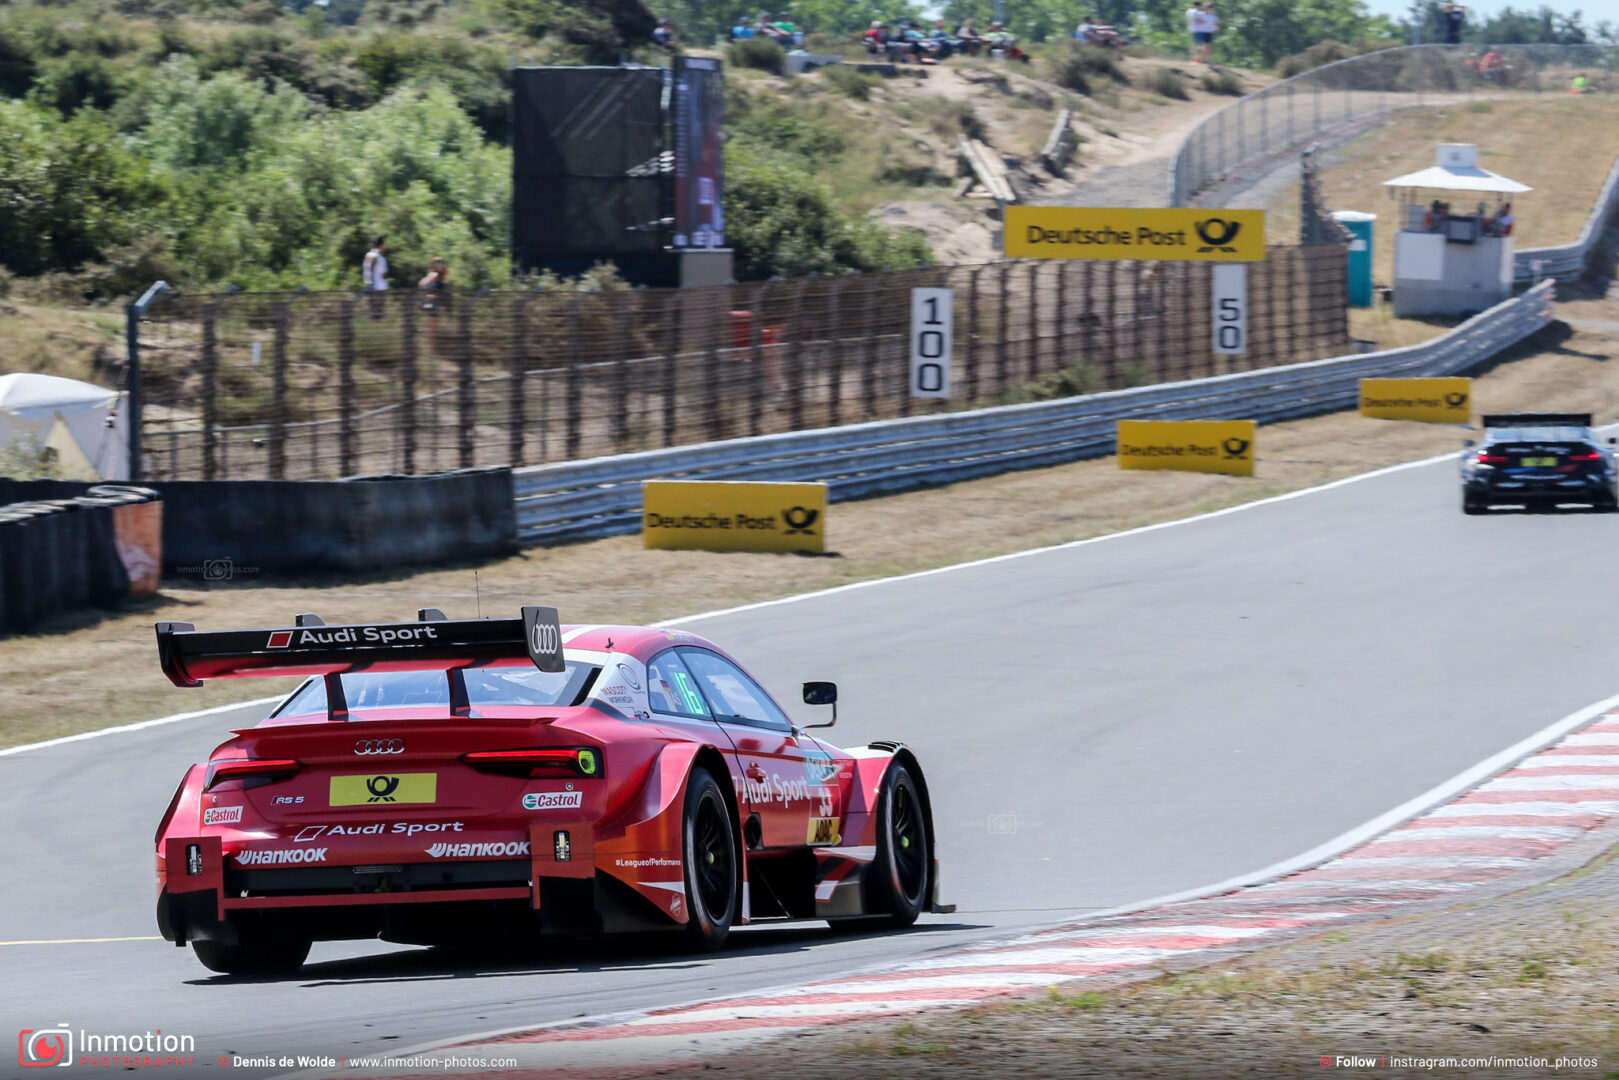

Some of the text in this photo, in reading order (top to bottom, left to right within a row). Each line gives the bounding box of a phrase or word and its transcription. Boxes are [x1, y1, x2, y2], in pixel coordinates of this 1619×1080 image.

[1027, 225, 1187, 247] Deutsche Post
[1218, 298, 1240, 350] 50
[918, 296, 944, 392] 100
[647, 512, 777, 530] Deutsche Post
[299, 625, 437, 645] Audi Sport
[275, 795, 305, 805] RS 5
[537, 793, 578, 807] Castrol
[741, 773, 812, 809] Audi Sport
[818, 787, 833, 817] 33
[210, 807, 240, 822] Castrol
[326, 821, 464, 837] Audi Sport
